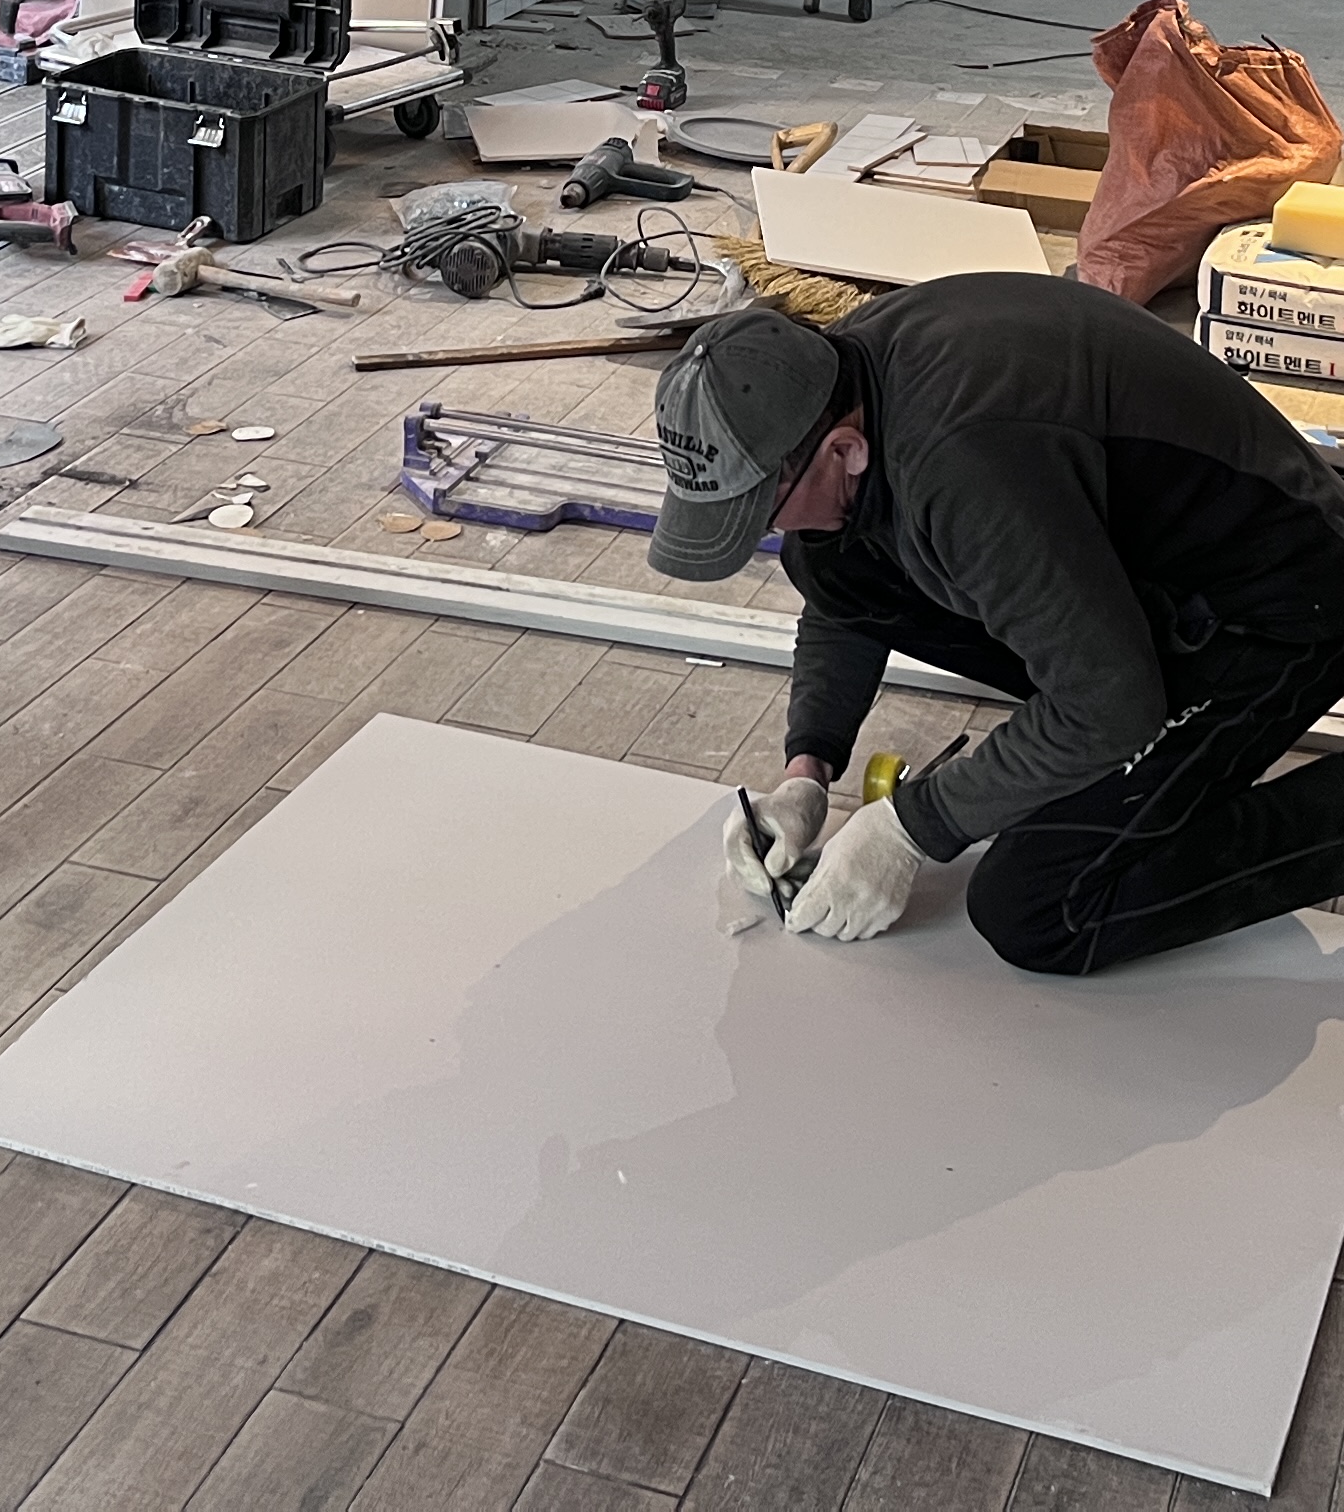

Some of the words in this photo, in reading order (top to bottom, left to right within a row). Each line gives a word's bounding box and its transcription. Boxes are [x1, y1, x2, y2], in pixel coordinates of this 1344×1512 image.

[1238, 284, 1259, 299] 압착
[1267, 289, 1288, 303] 백색
[1235, 300, 1337, 332] 화이트멘트
[1224, 329, 1245, 344] 압착
[1254, 334, 1274, 348] 백색
